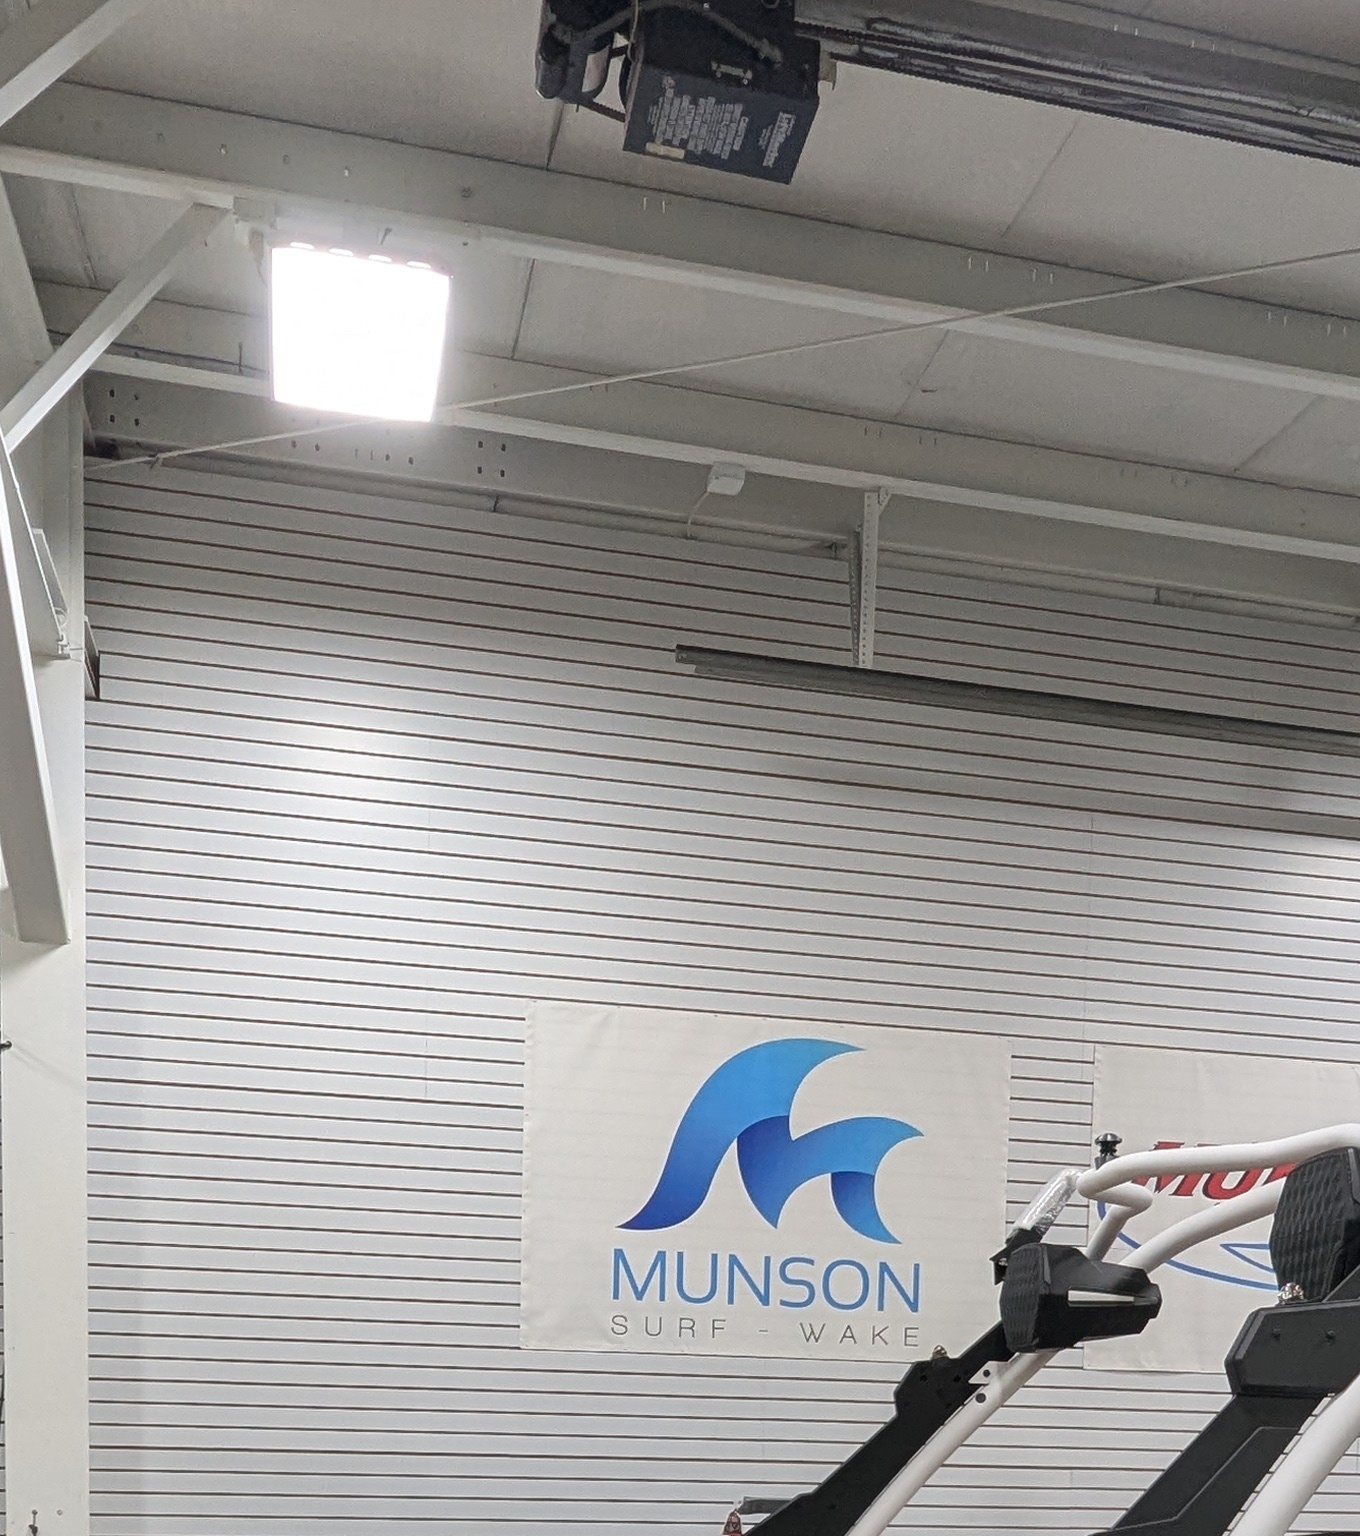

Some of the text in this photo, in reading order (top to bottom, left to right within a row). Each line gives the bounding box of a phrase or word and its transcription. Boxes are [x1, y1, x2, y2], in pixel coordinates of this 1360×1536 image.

[610, 1247, 921, 1314] MUNSON
[610, 1314, 727, 1339] SURF
[798, 1322, 921, 1348] WAKE
